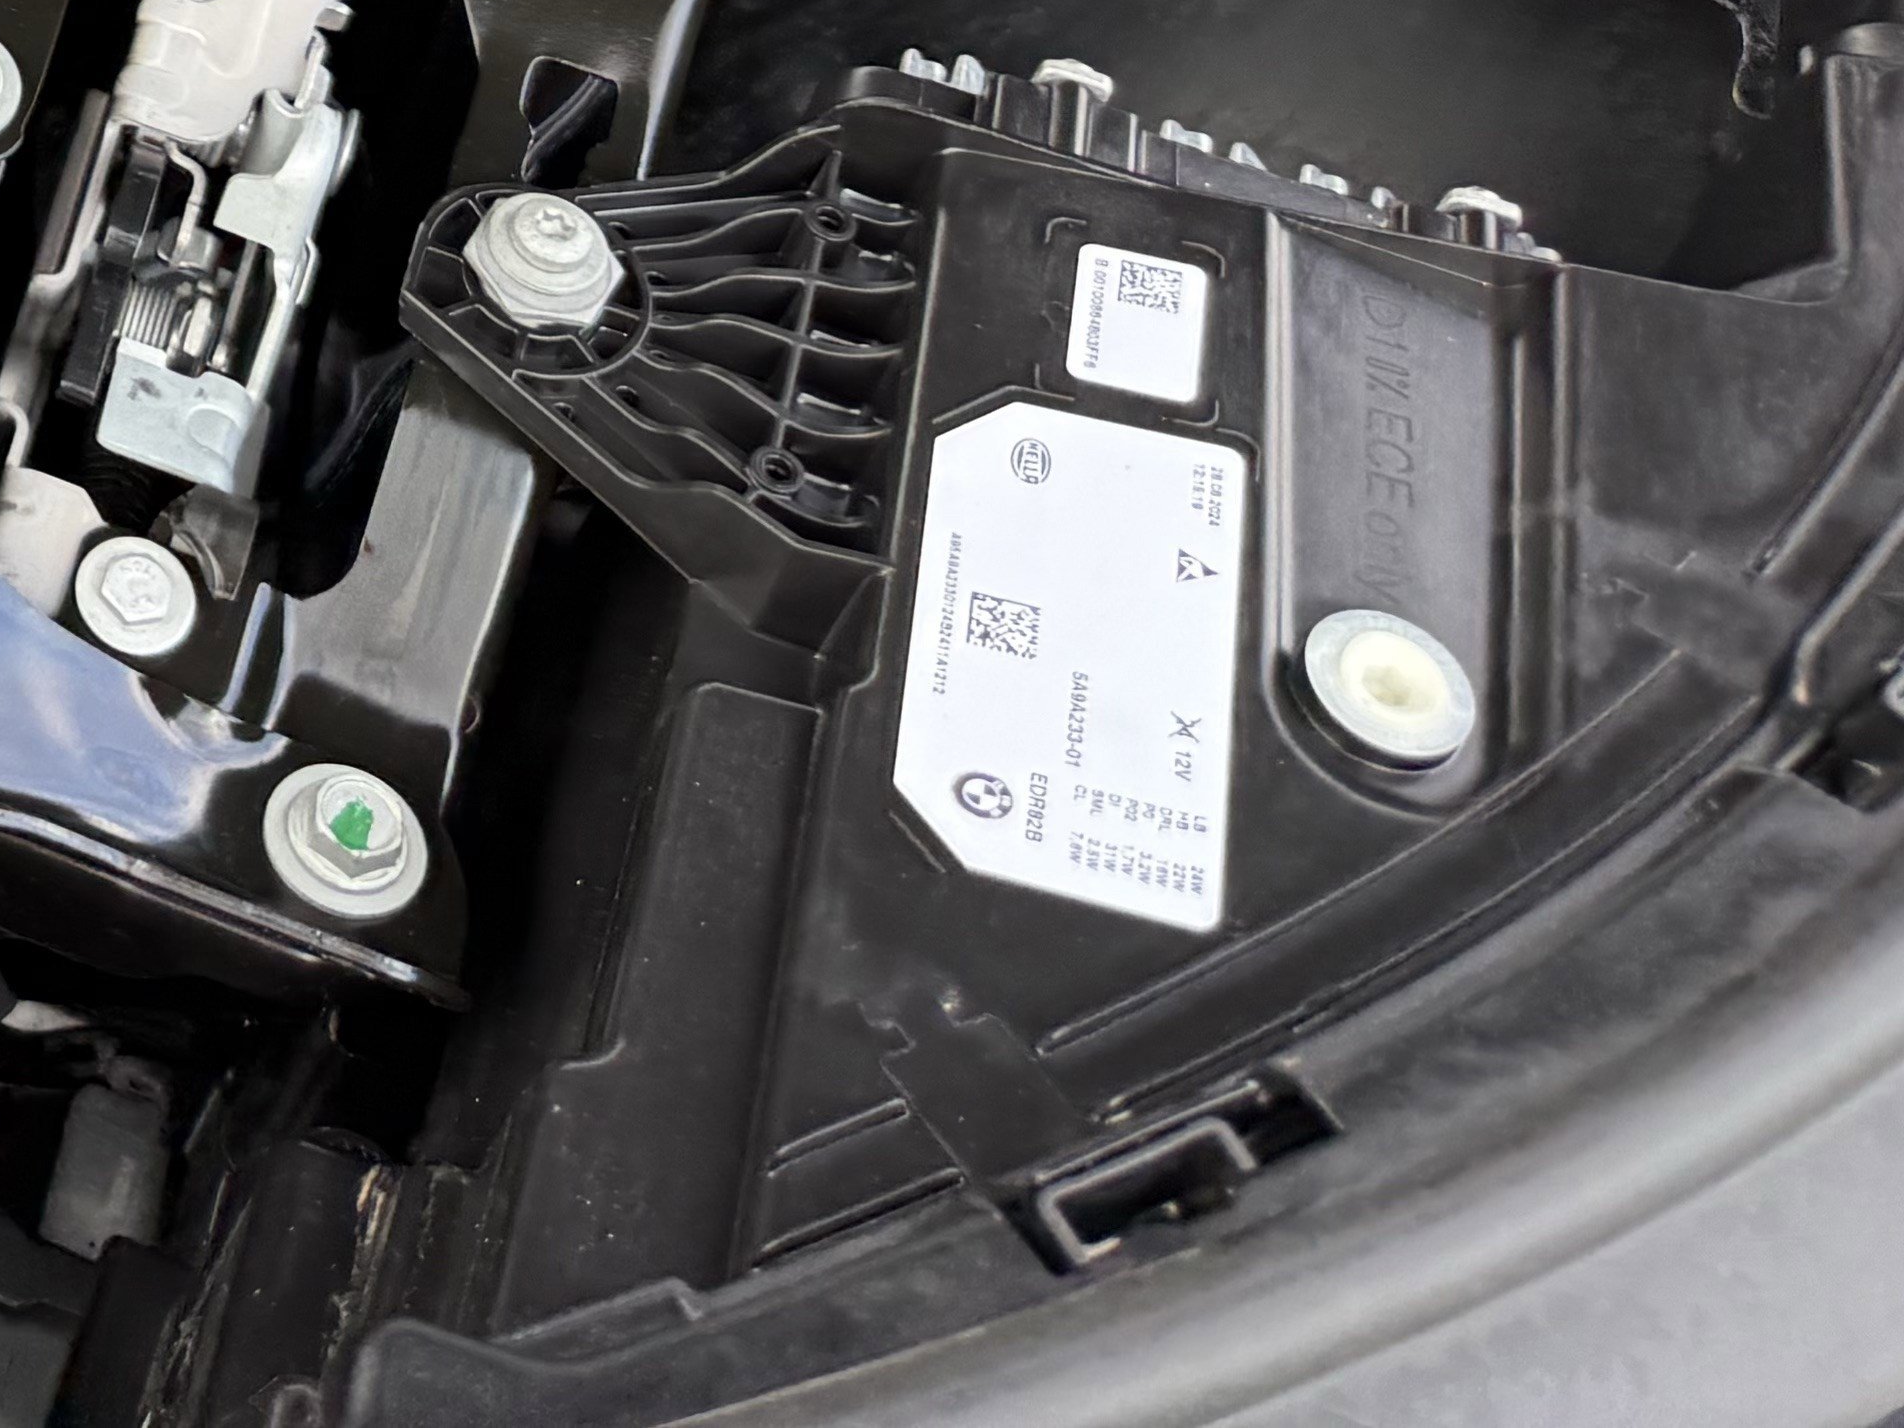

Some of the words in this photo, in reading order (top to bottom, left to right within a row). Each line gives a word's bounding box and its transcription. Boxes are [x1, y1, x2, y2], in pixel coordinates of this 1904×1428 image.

[1065, 670, 1089, 768] 5A9A233-01
[1174, 751, 1192, 783] 12V
[1073, 784, 1087, 801] CL
